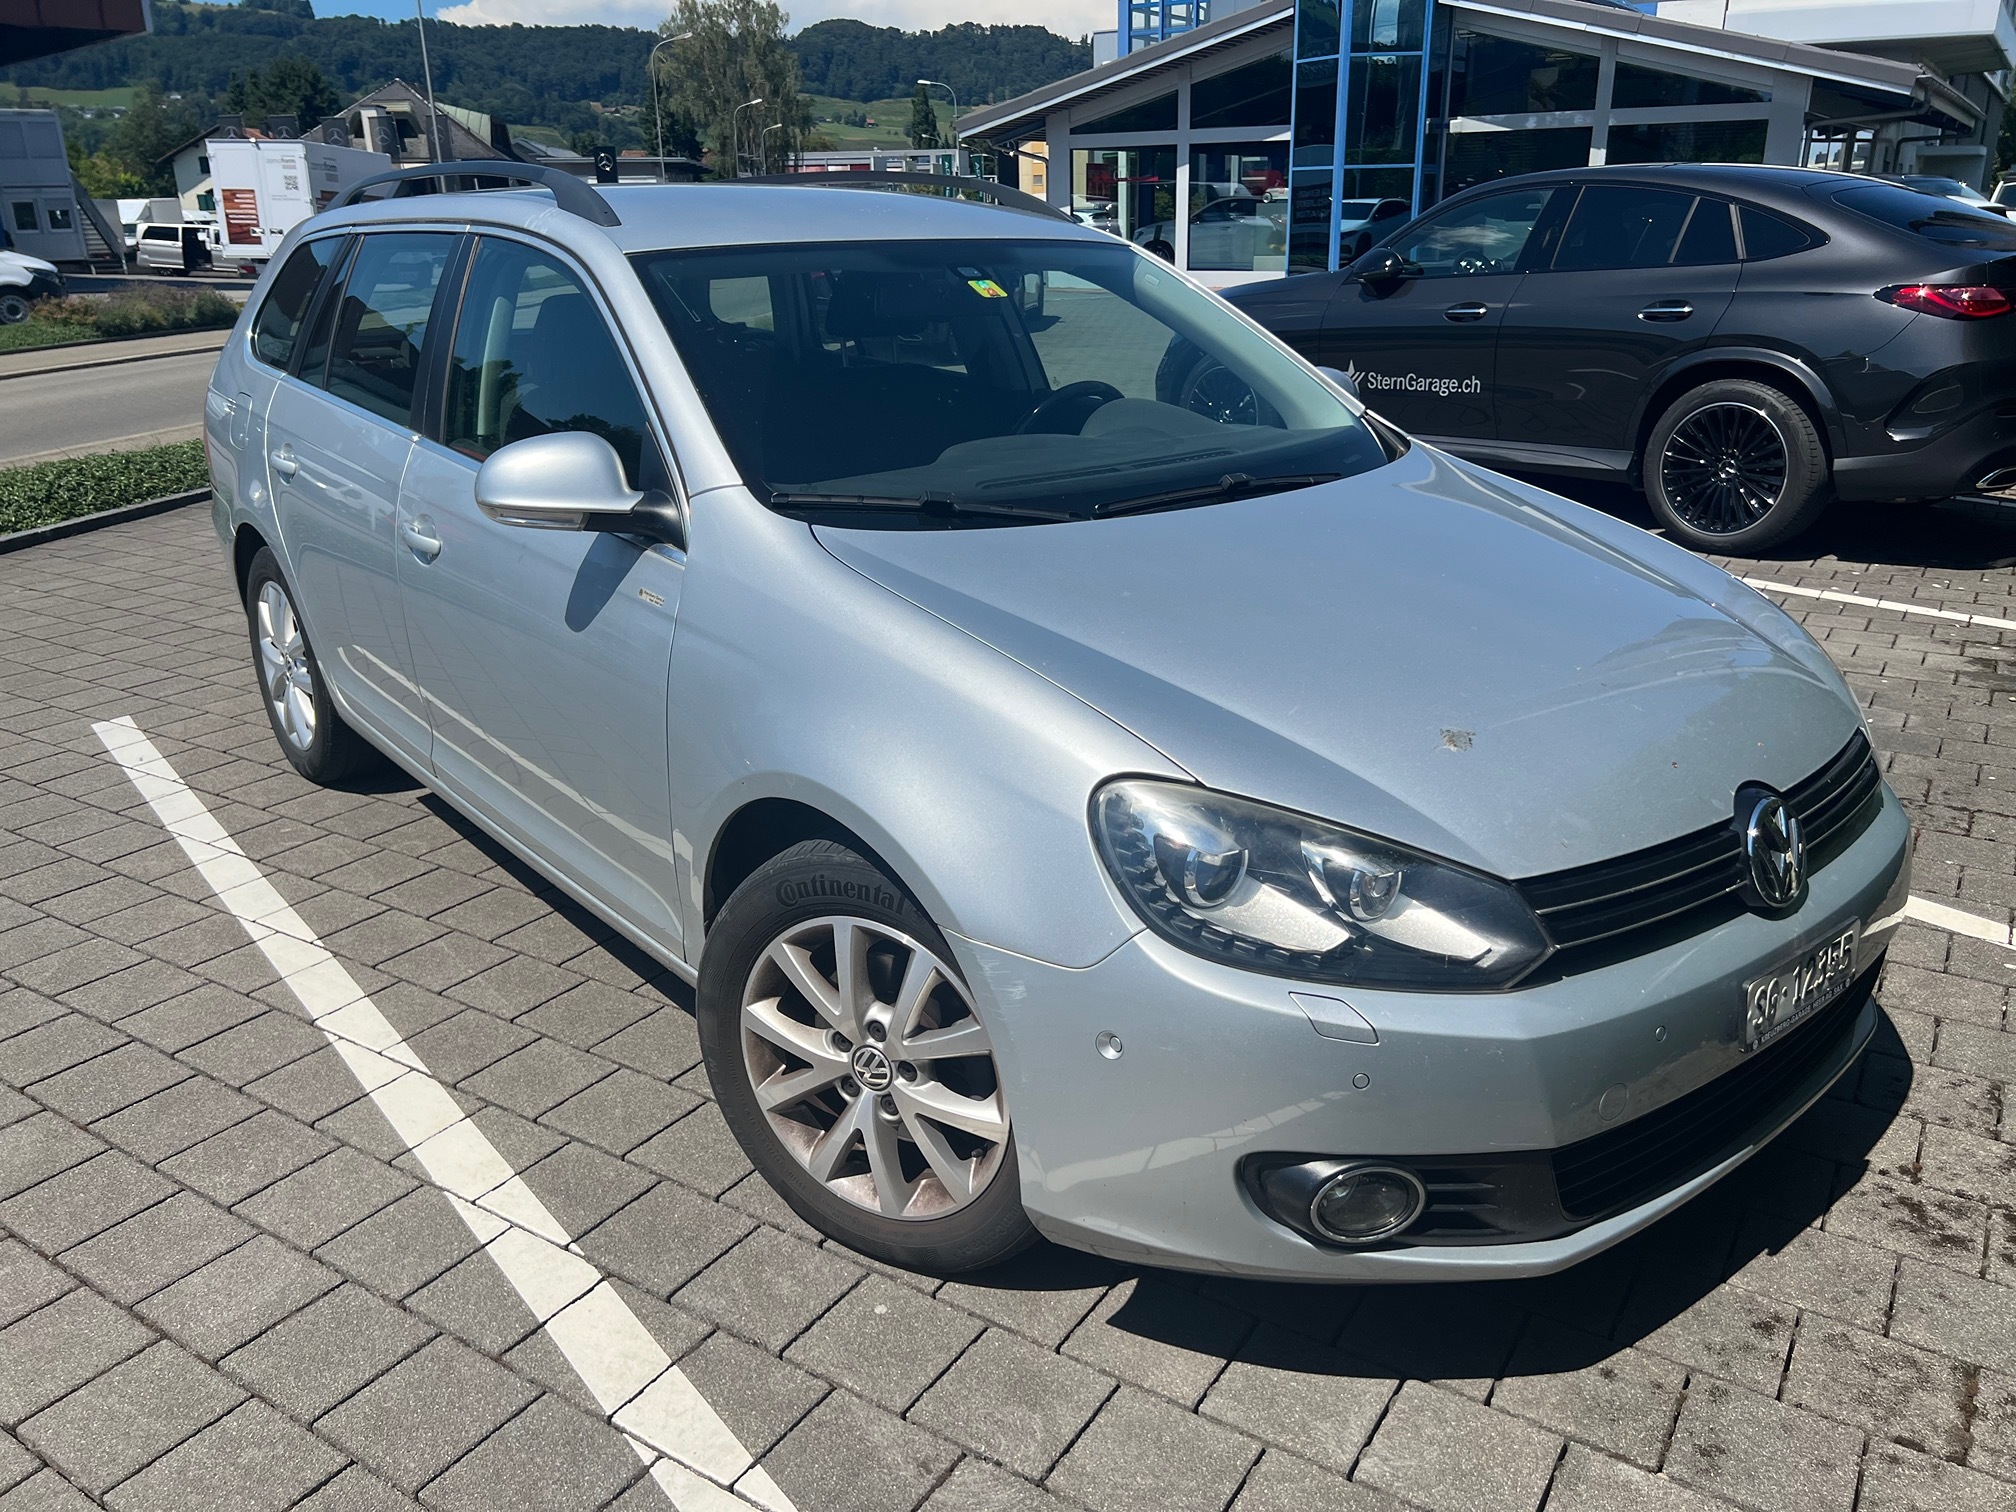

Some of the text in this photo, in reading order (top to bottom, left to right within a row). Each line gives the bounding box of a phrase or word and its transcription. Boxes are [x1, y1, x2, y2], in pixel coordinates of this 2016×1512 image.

[1367, 372, 1481, 397] SternGarage.ch
[775, 873, 907, 916] Continental
[1752, 977, 1780, 1036] SG
